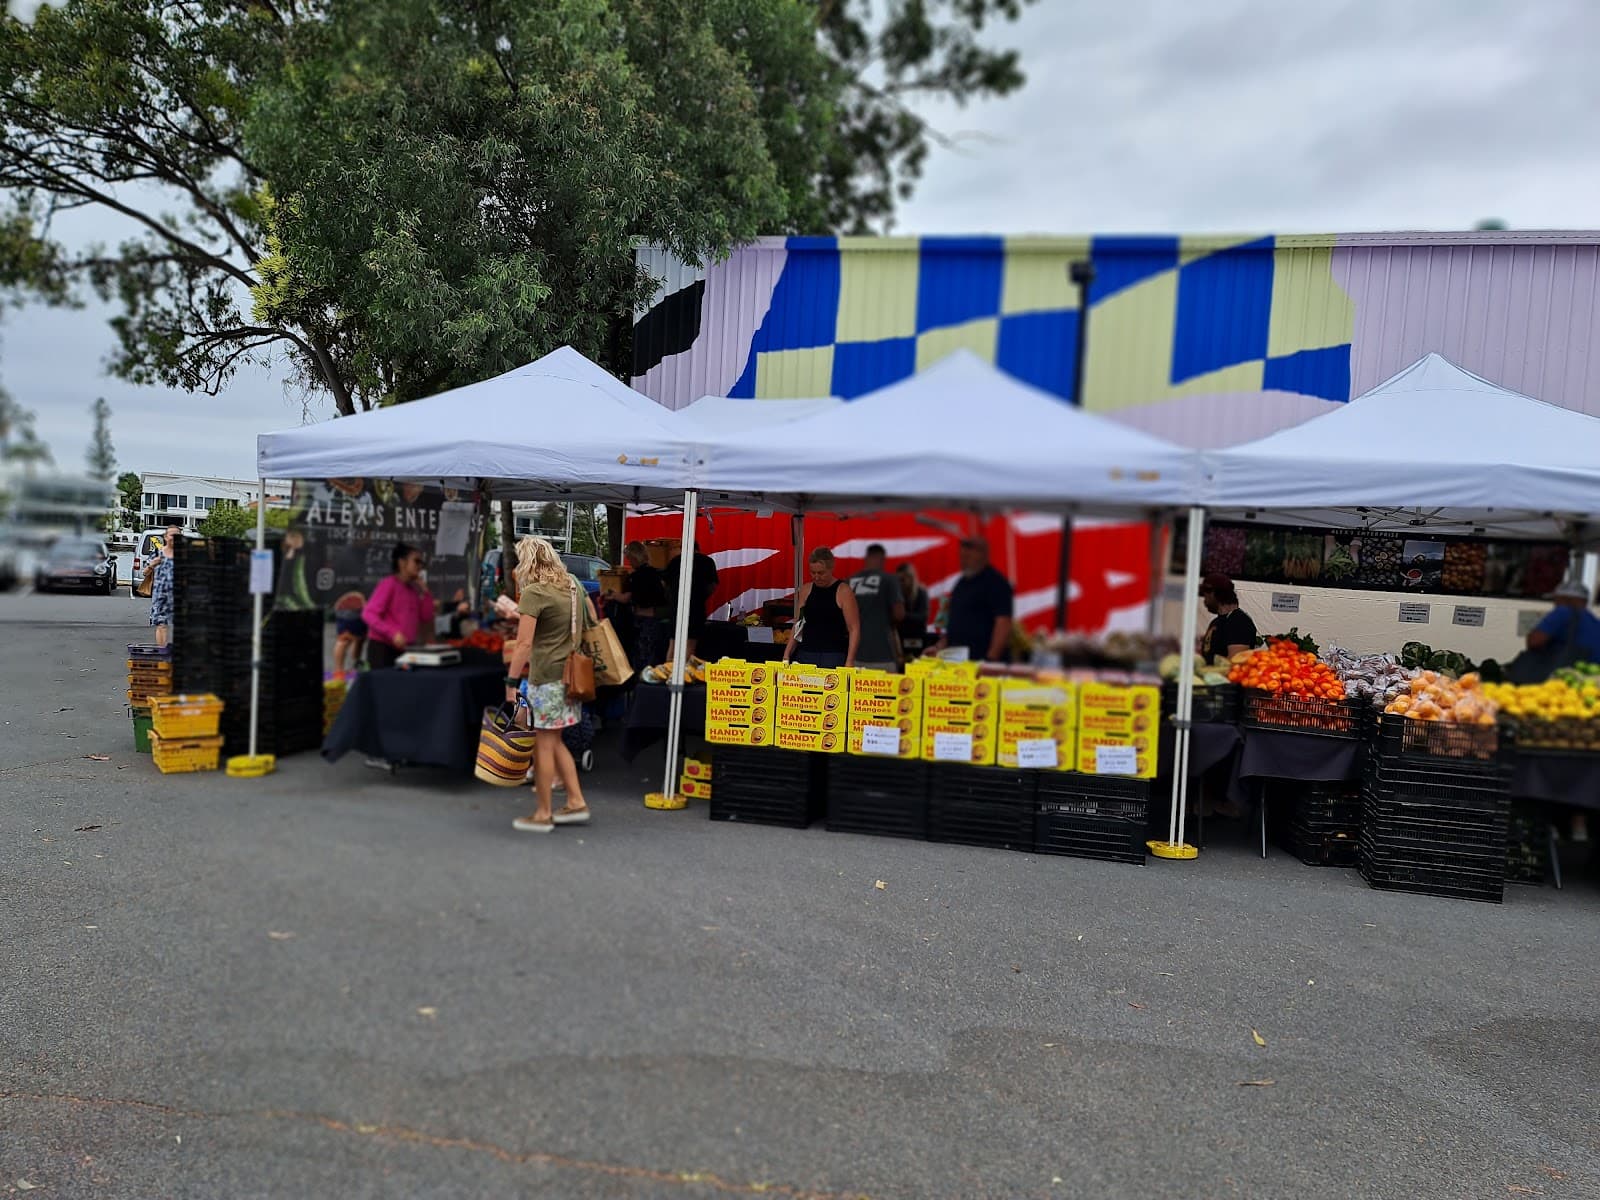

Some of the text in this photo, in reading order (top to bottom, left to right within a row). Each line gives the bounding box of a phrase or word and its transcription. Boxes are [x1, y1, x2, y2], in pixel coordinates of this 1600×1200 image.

[306, 501, 484, 532] ALEX'S ENTESE
[1357, 530, 1399, 538] ENTERPRISE
[710, 669, 746, 678] HANDY
[855, 679, 893, 687] HANDY
[711, 689, 748, 697] HANDY
[929, 684, 969, 693] HANDY
[782, 694, 819, 703] HANDY
[853, 699, 892, 707] HANDY
[782, 702, 818, 710] Mangoes
[928, 705, 967, 715] HANDY
[710, 708, 747, 717] HANDY
[780, 713, 818, 722] HANDY
[852, 719, 891, 727] HANDY
[709, 728, 746, 737] HANDY
[779, 732, 817, 742] HANDY
[710, 735, 745, 743] Mangoes
[780, 740, 816, 748] Mangoes
